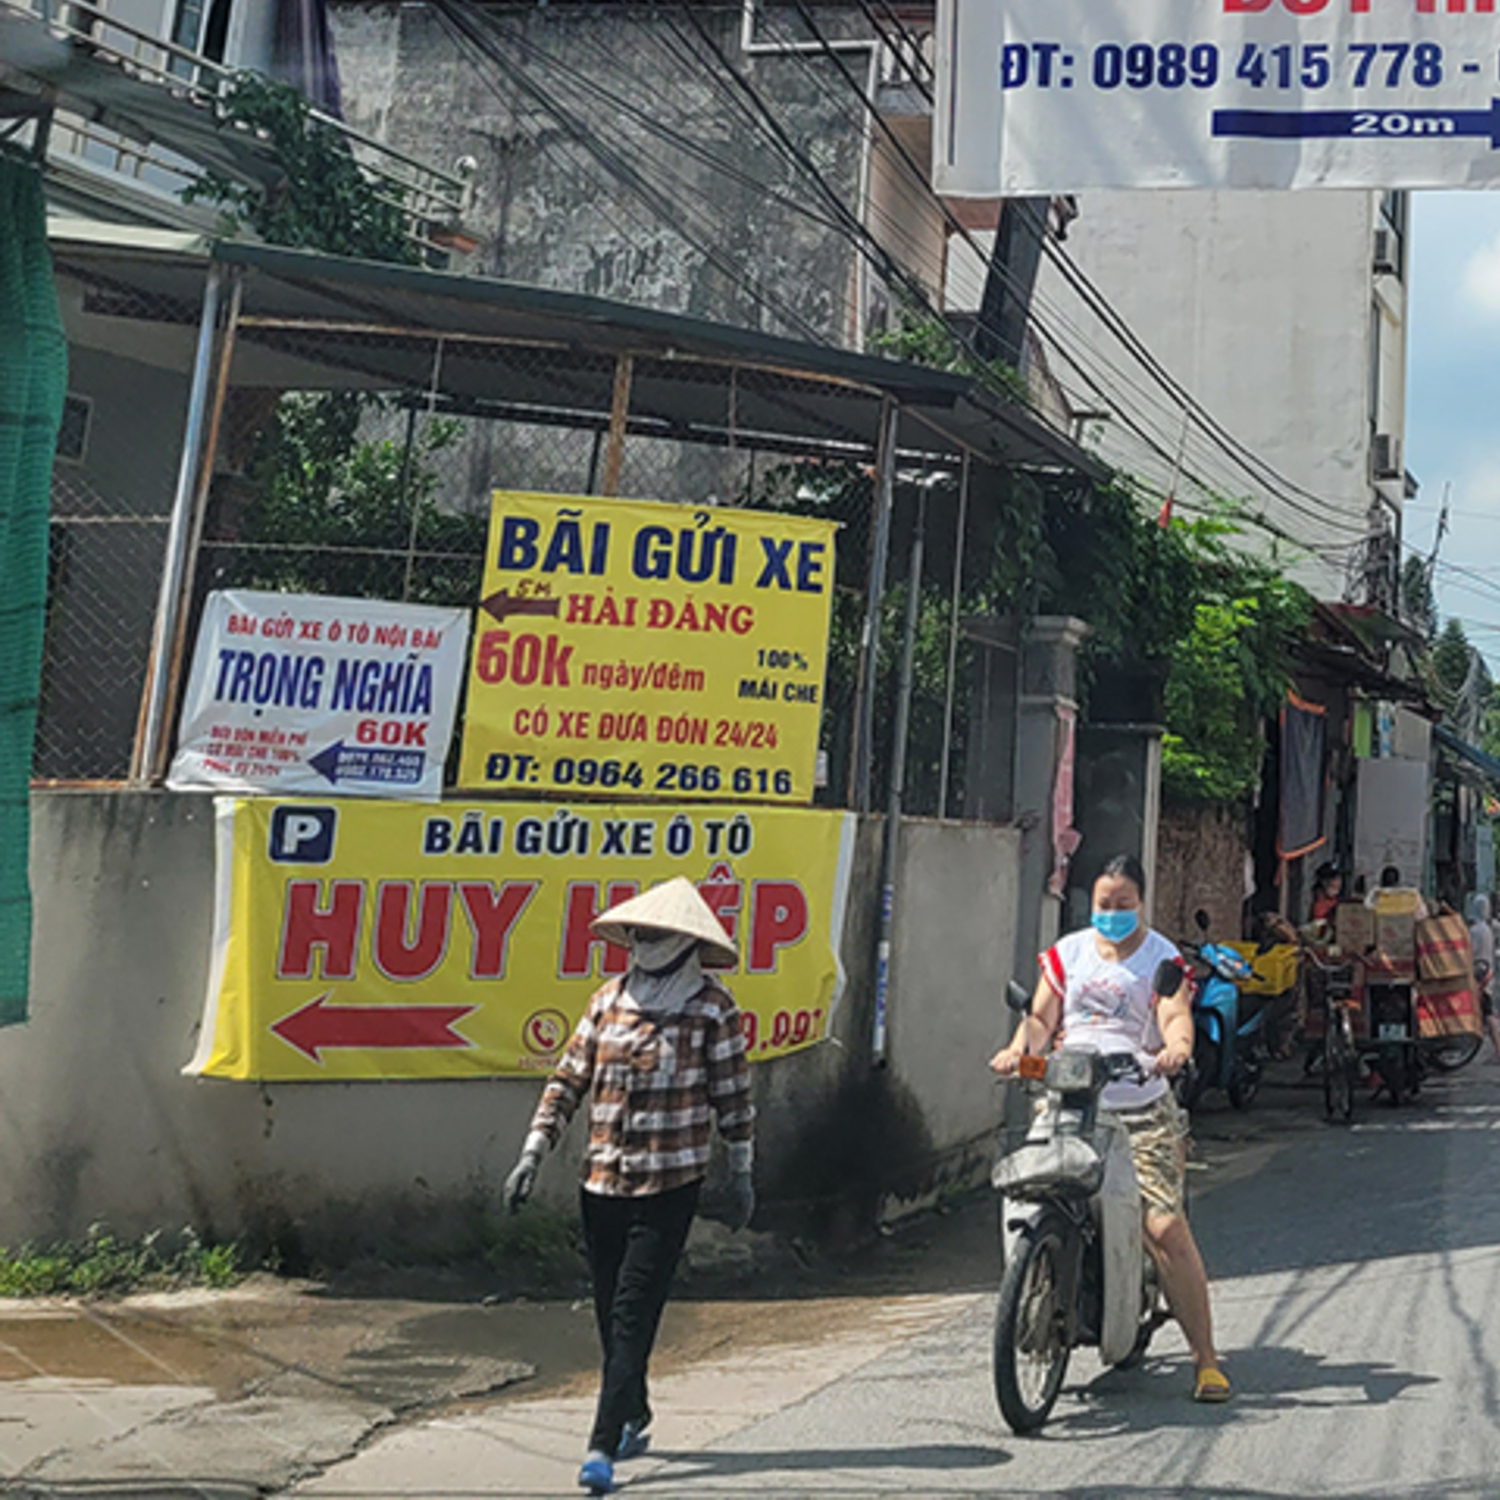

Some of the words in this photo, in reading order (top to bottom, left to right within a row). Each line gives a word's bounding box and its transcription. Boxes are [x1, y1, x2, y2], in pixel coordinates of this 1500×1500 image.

[1000, 43, 1075, 89] ĐT:
[1092, 43, 1219, 89] 0989
[1236, 43, 1331, 89] 415
[1347, 42, 1443, 88] 778
[1351, 113, 1455, 133] 20m
[496, 508, 611, 576] BÃI
[631, 511, 738, 586] GỬI
[755, 536, 826, 595] XE
[298, 620, 323, 641] XE
[215, 649, 325, 716] TRỌNG
[330, 654, 433, 715] NGHĨA
[476, 630, 574, 688] 60k
[757, 649, 809, 671] 100%
[783, 682, 819, 703] CHE
[356, 719, 429, 747] 60K
[514, 703, 548, 738] CÓ
[556, 711, 590, 740] XE
[597, 711, 648, 743] ĐƯA
[656, 710, 709, 746] ĐÓN
[714, 720, 778, 750] 24/24
[485, 752, 541, 783] ĐT:
[553, 757, 643, 790] 0964
[656, 762, 721, 793] 266
[733, 766, 792, 795] 616
[425, 812, 503, 855] BÃI
[516, 810, 589, 856] GỬI
[602, 820, 654, 855] XE
[667, 813, 690, 856] Ô
[704, 815, 752, 857] TÔ
[277, 880, 540, 981] HUY
